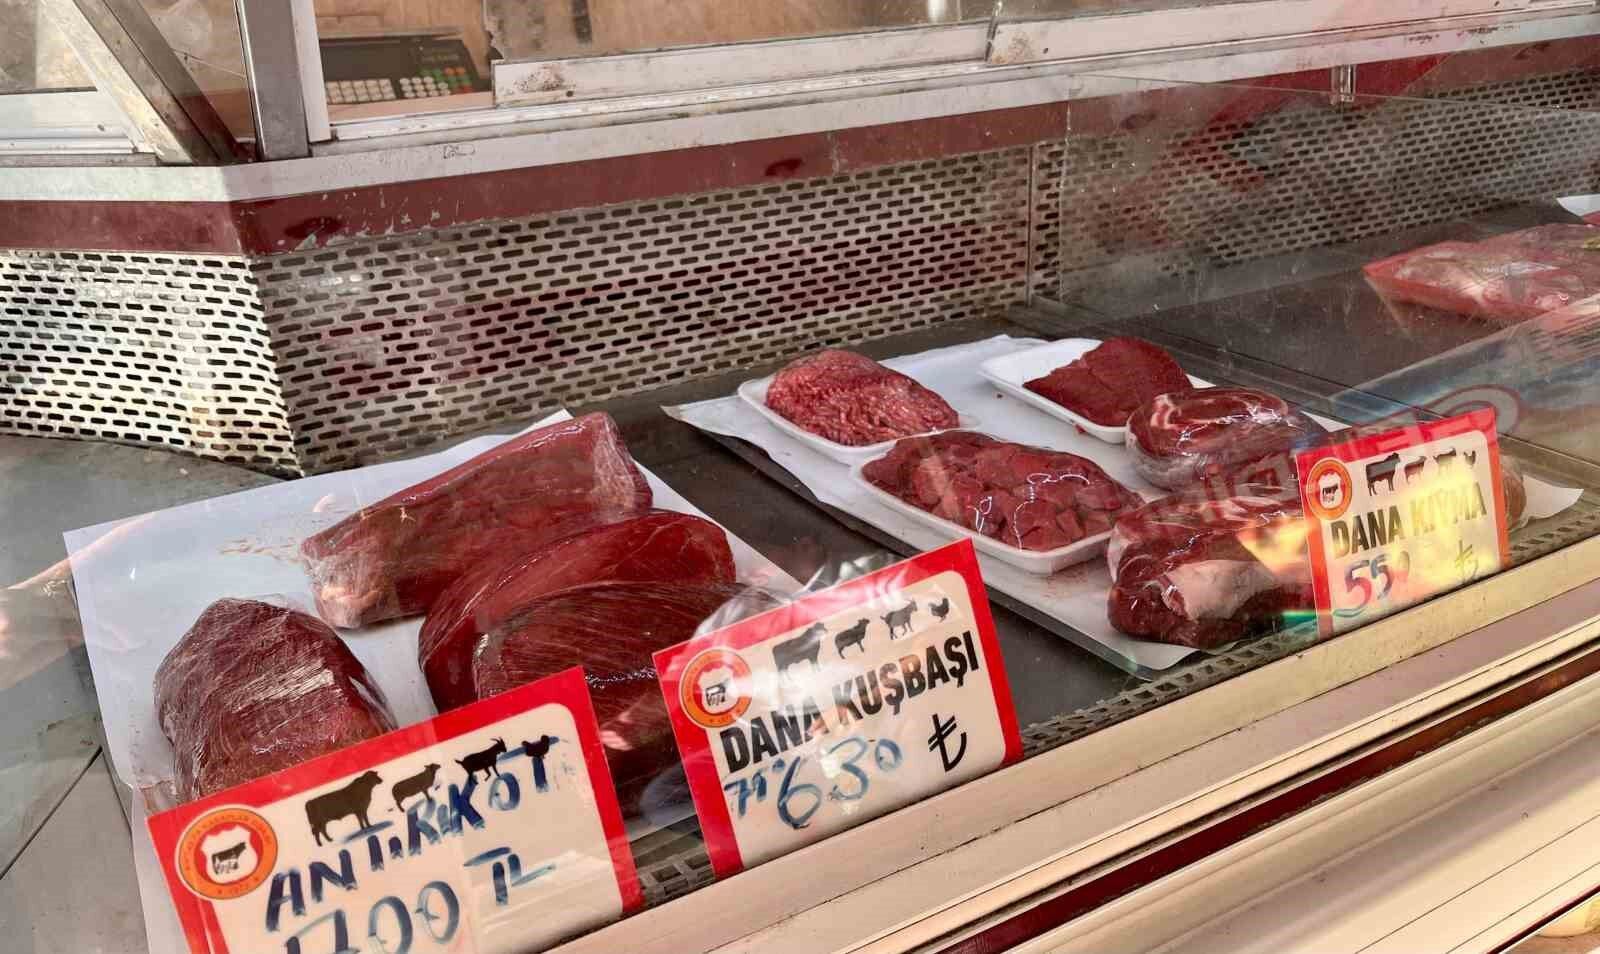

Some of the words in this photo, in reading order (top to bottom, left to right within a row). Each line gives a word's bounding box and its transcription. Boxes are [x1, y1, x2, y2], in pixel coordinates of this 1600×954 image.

[1330, 504, 1406, 560] DANA
[719, 692, 831, 774] DANA
[831, 629, 980, 724] KUŞBAŞI
[777, 735, 903, 830] 630
[462, 845, 557, 906] TL
